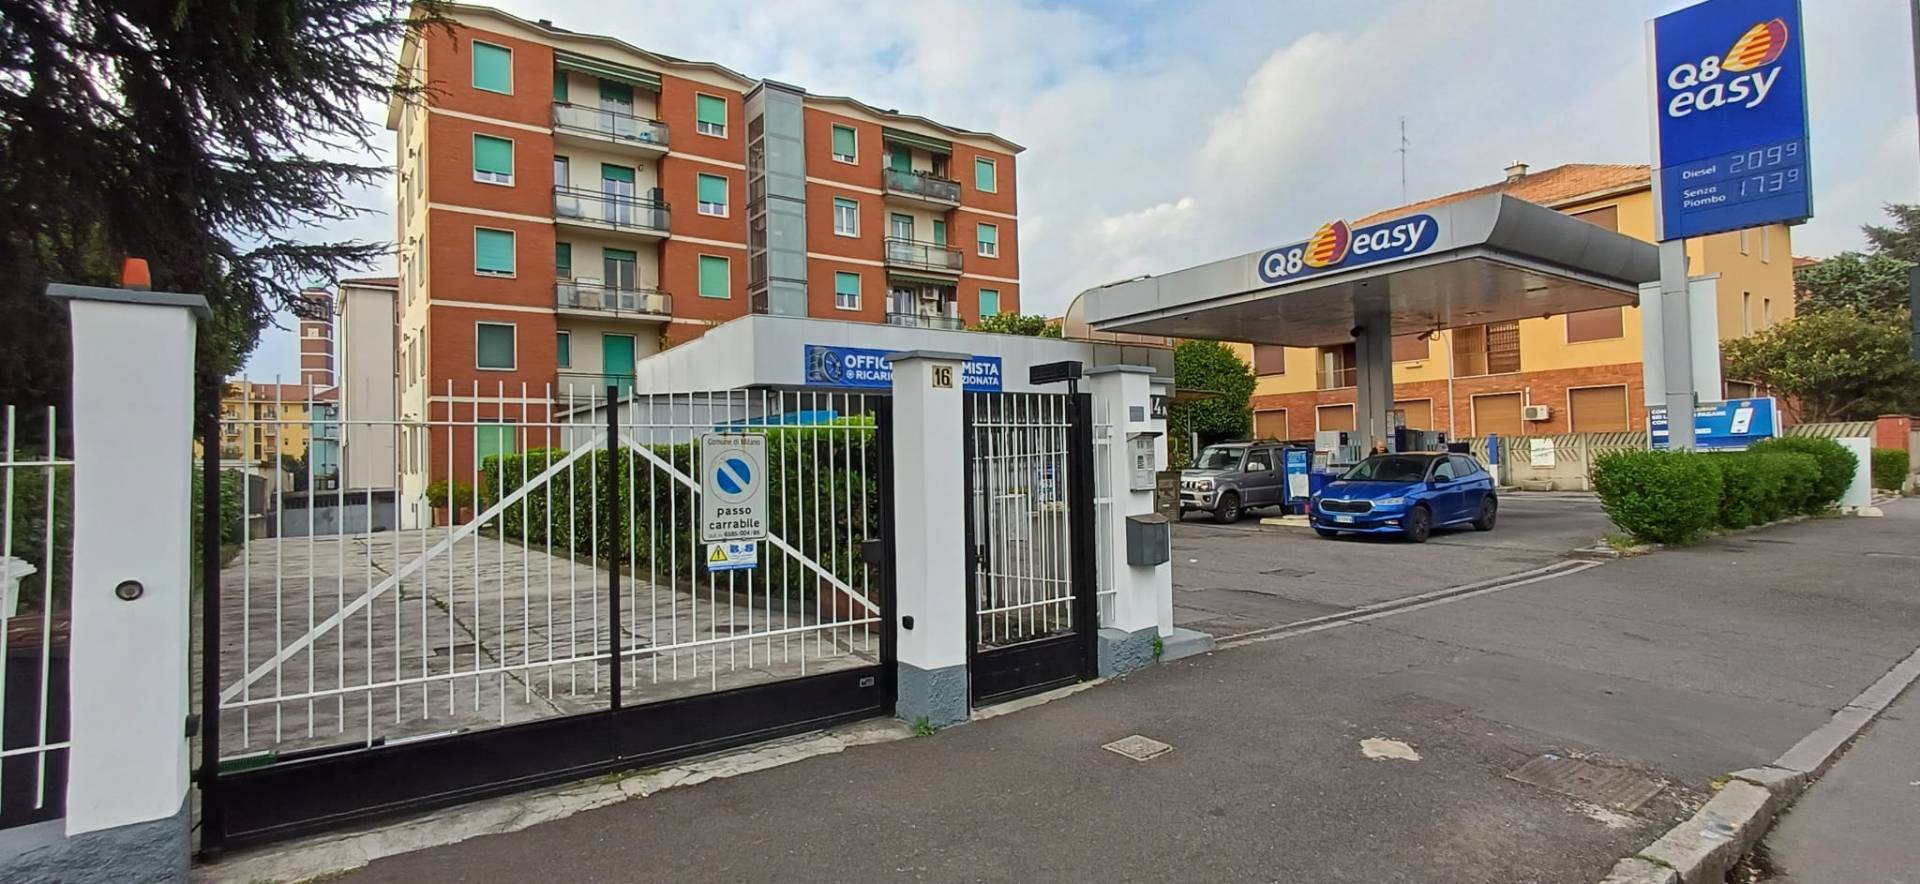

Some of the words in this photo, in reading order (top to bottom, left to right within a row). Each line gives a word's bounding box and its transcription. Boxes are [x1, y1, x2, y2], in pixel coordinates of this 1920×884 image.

[1667, 55, 1721, 90] Q8
[1668, 66, 1782, 118] easy
[1682, 165, 1716, 180] Diesel
[1683, 185, 1717, 198] Senza
[1683, 193, 1726, 208] Piombo
[1264, 248, 1303, 278] Q8
[1352, 219, 1428, 255] easy
[855, 370, 894, 381] RICARI
[934, 367, 951, 386] 16
[717, 506, 752, 518] passo
[709, 519, 760, 530] carrabile
